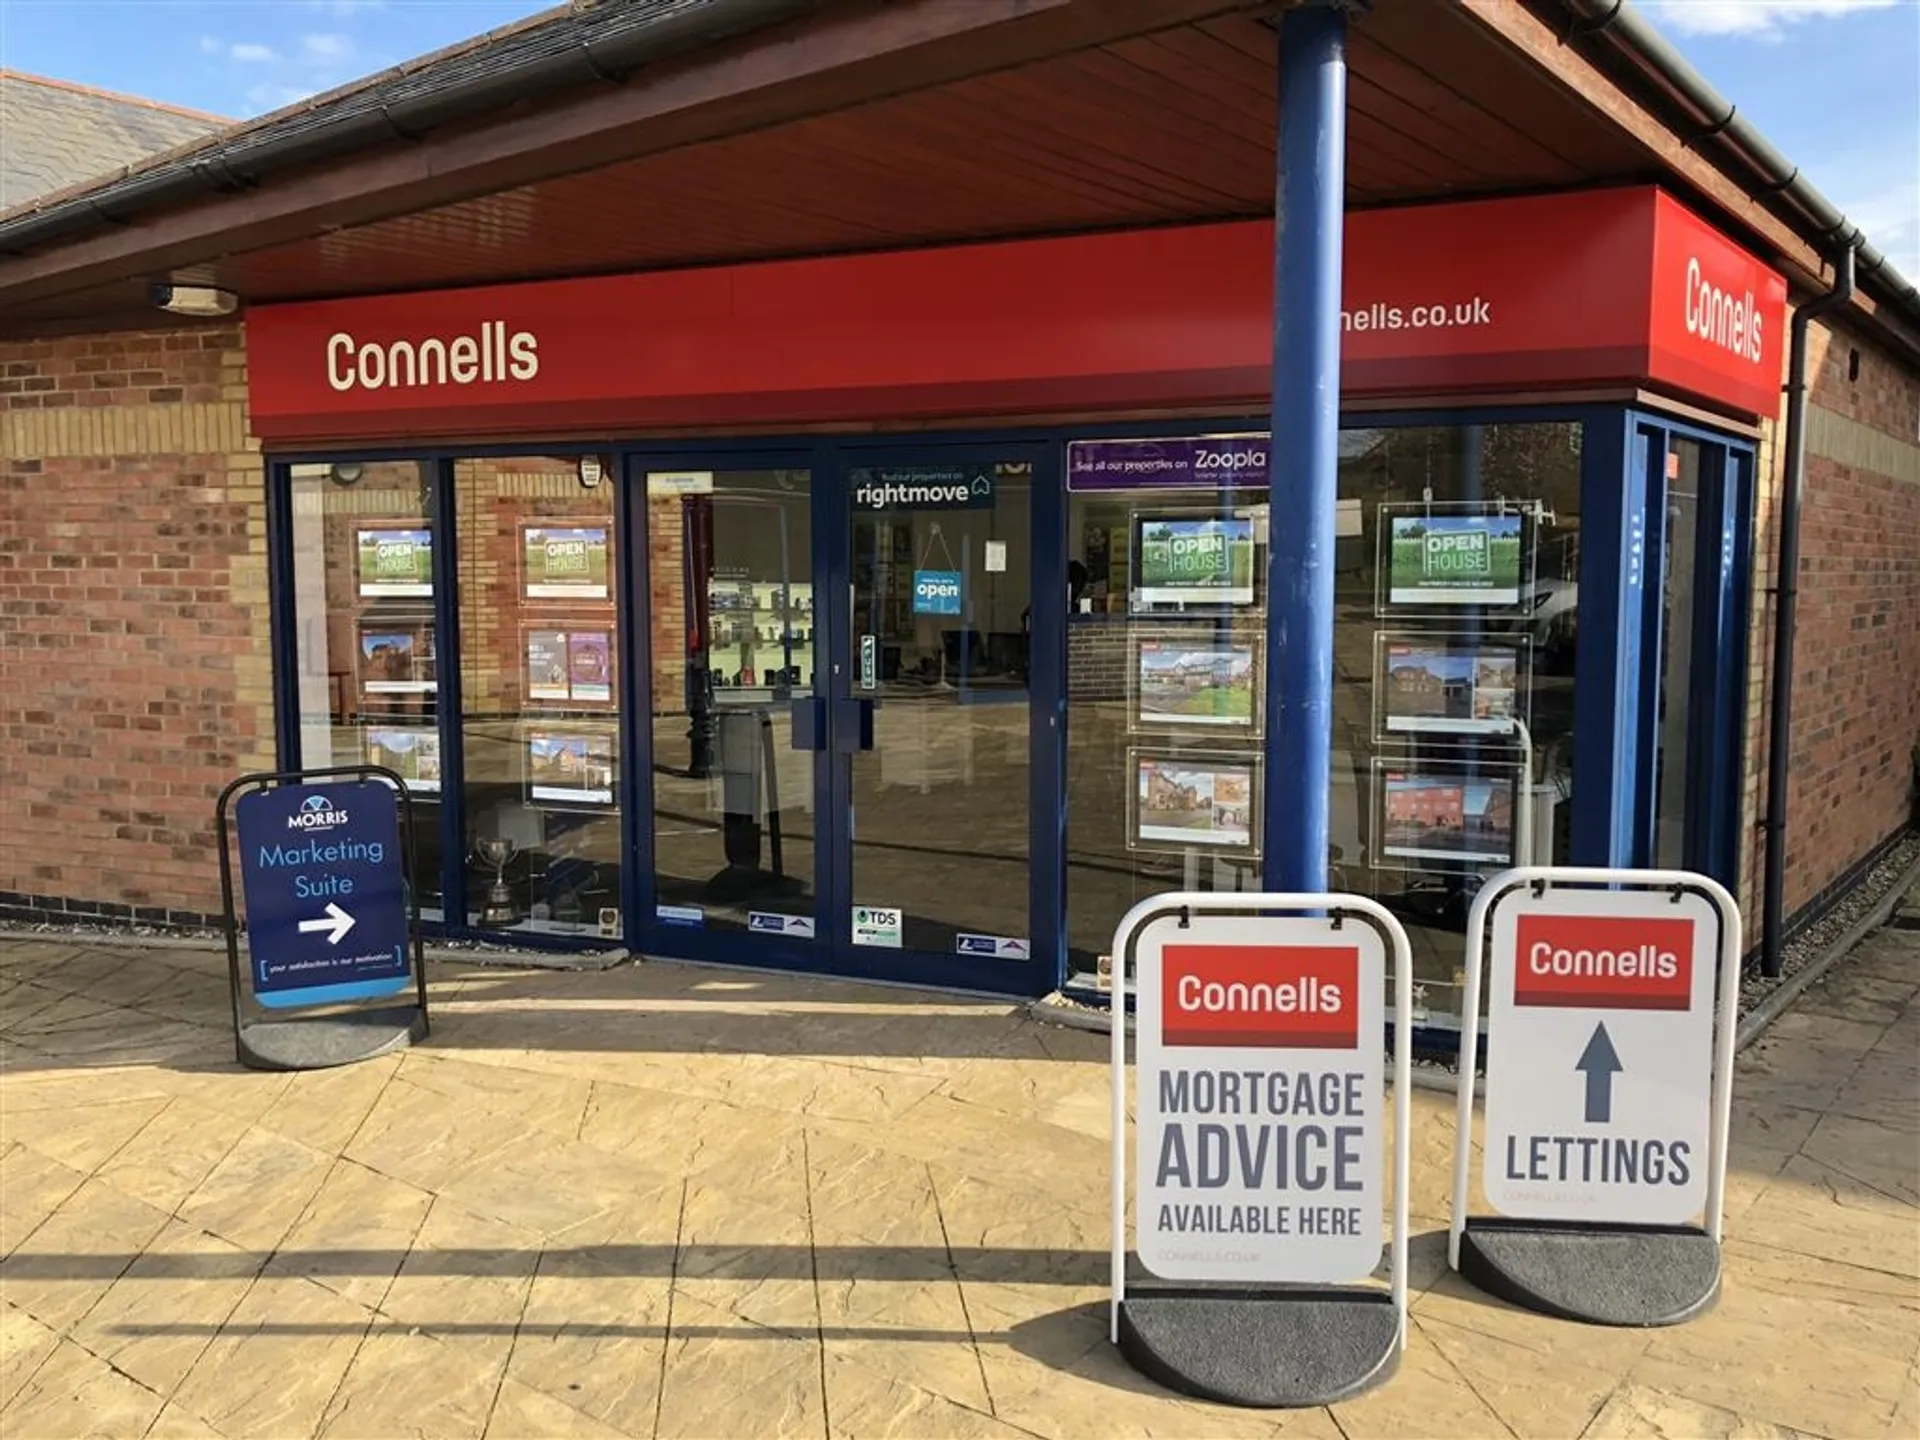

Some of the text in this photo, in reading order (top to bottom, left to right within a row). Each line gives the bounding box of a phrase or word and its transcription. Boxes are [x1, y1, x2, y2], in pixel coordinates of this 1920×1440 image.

[1685, 256, 1762, 364] Connells
[328, 320, 539, 392] Connells
[1107, 462, 1123, 470] our
[1125, 460, 1173, 473] properties
[1175, 461, 1188, 469] on
[1195, 448, 1266, 470] Zoopla
[856, 482, 969, 509] rightmove
[547, 541, 586, 557] OPEN
[1173, 537, 1223, 555] OPEN
[1426, 533, 1485, 553] OPEN
[1173, 553, 1224, 571] HOUSE
[1427, 551, 1486, 571] HOUSE
[916, 583, 958, 600] open
[287, 810, 349, 829] MORRIS
[259, 838, 384, 868] Marketing
[295, 873, 354, 898] Suite
[870, 911, 897, 926] TDS
[1530, 941, 1678, 979] Connells
[1178, 974, 1343, 1014] Connells
[1159, 1069, 1365, 1117] MORTGAGE
[1155, 1122, 1365, 1192] ADVICE
[1506, 1135, 1691, 1187] LETTINGS
[1158, 1203, 1362, 1236] AVAILABLE HERE
